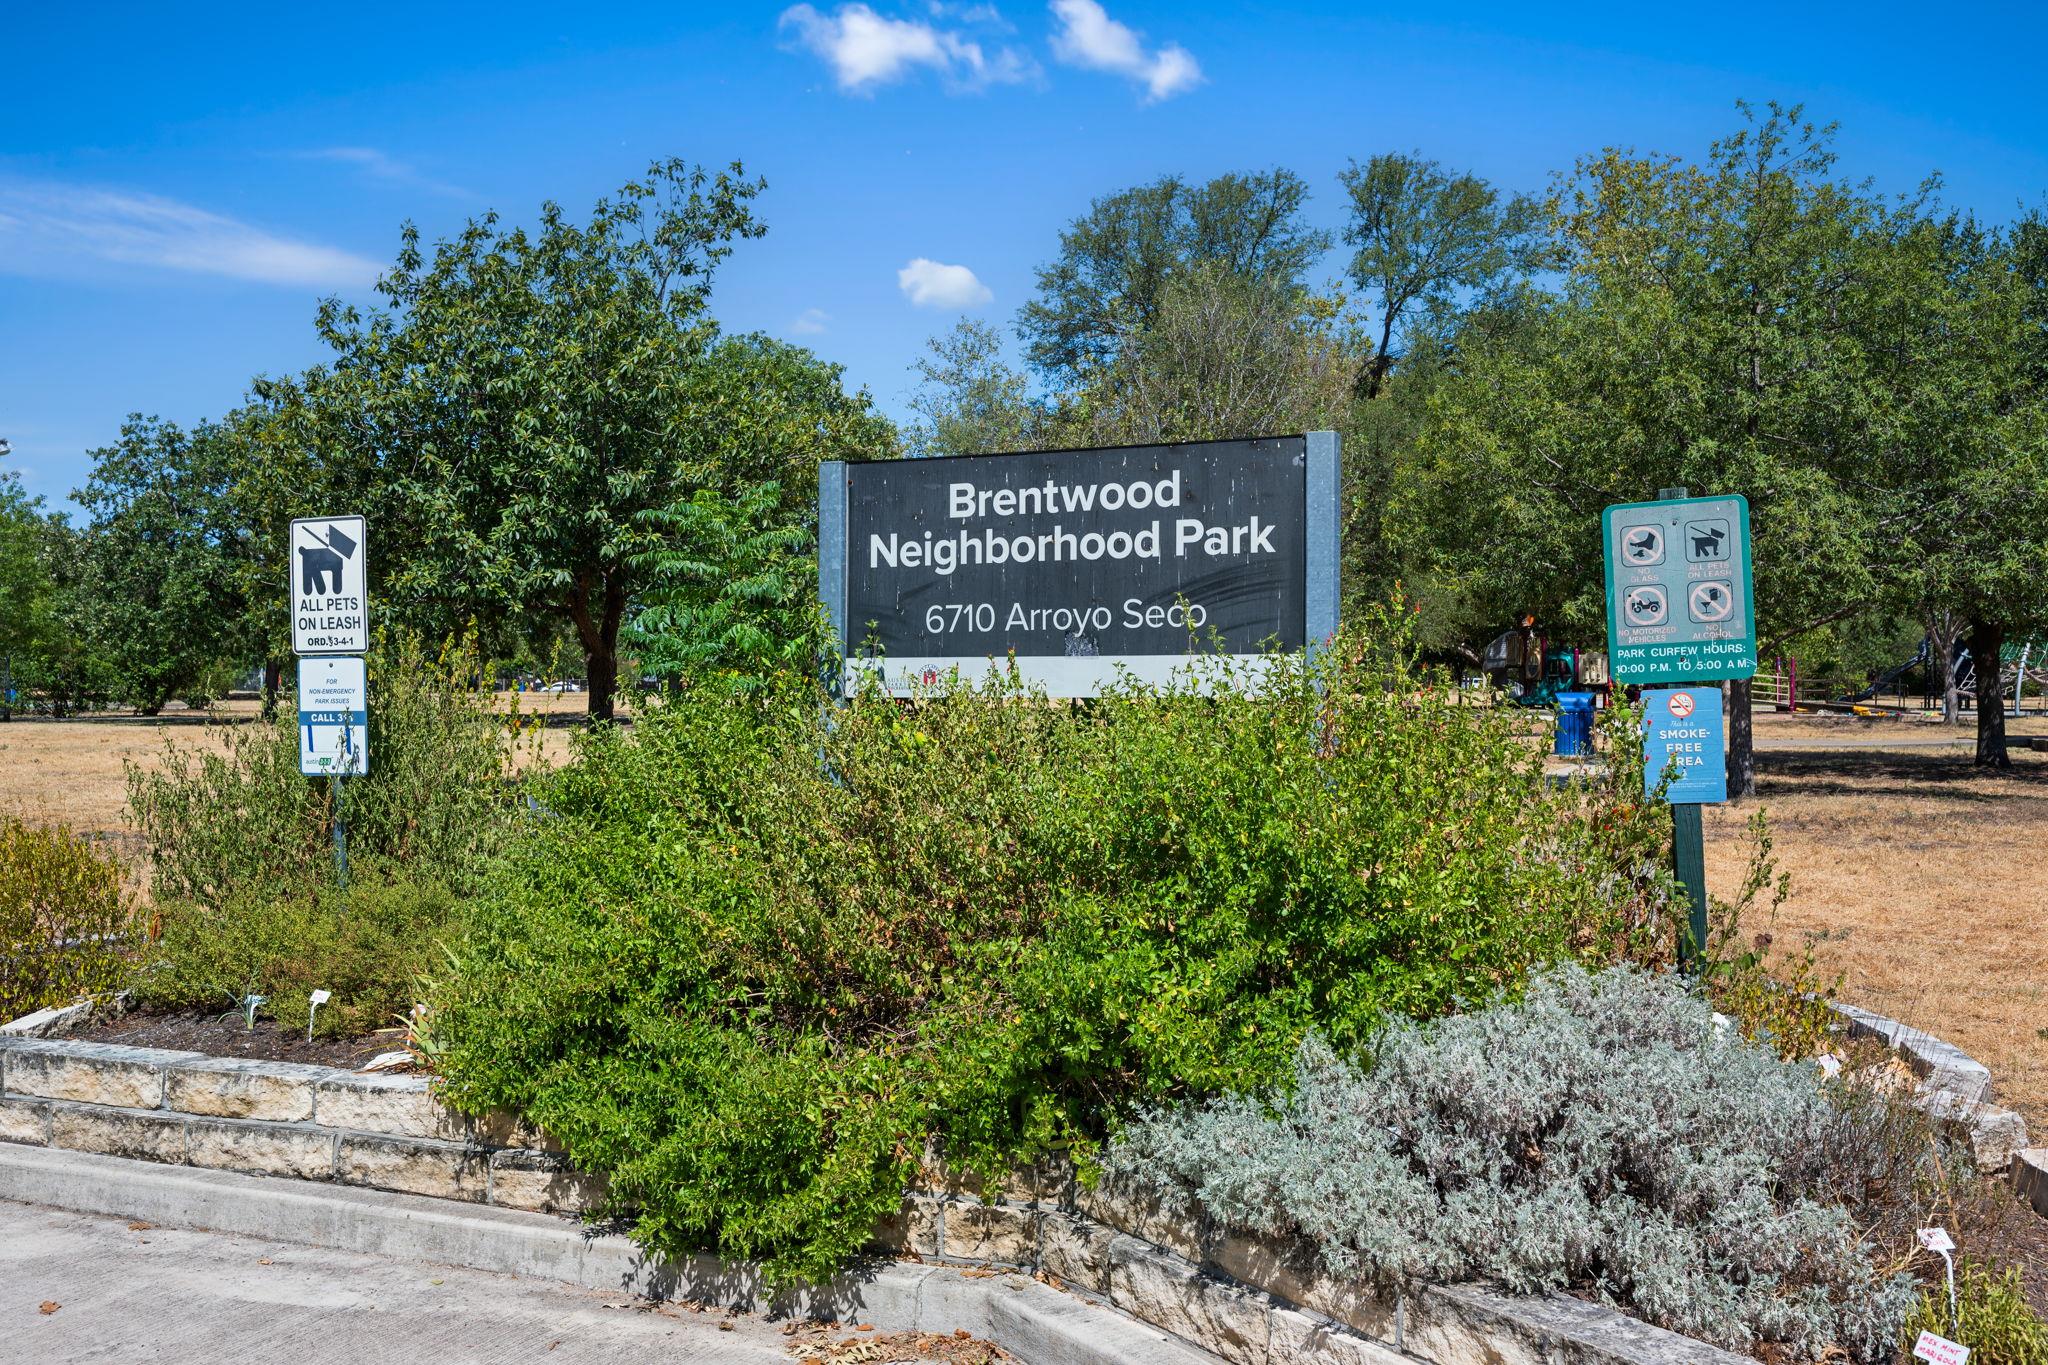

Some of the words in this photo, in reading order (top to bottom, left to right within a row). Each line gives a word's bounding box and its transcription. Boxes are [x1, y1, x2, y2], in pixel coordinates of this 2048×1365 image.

[949, 470, 1180, 518] Brentwood
[870, 520, 1160, 575] Neighborhood
[1175, 516, 1276, 557] Park
[1637, 567, 1651, 575] NO
[1707, 562, 1729, 570] PETS
[1630, 575, 1659, 583] GLASS
[1687, 571, 1700, 579] ON
[1703, 570, 1732, 578] LEASH
[300, 598, 323, 612] ALL
[326, 597, 358, 612] PETS
[298, 617, 316, 631] ON
[320, 616, 360, 630] LEASH
[925, 603, 996, 633] 6710
[1005, 602, 1112, 637] Arroyo
[1123, 599, 1207, 629] Seco
[1618, 629, 1630, 637] NO
[1632, 627, 1677, 636] MOTORIZED
[1692, 630, 1733, 640] ALCOHOL
[1628, 635, 1666, 643] VEHICLES
[1617, 649, 1645, 658] PARK
[1651, 646, 1698, 657] CURFEW
[1703, 643, 1746, 654] HOURS:
[1615, 664, 1645, 673] 10:00
[1650, 663, 1672, 672] P.M.
[1676, 662, 1691, 671] TO
[1696, 660, 1722, 670] 5:00
[310, 713, 335, 722] CALL
[1659, 728, 1711, 739] SMOKE-
[1665, 742, 1702, 753] FREE
